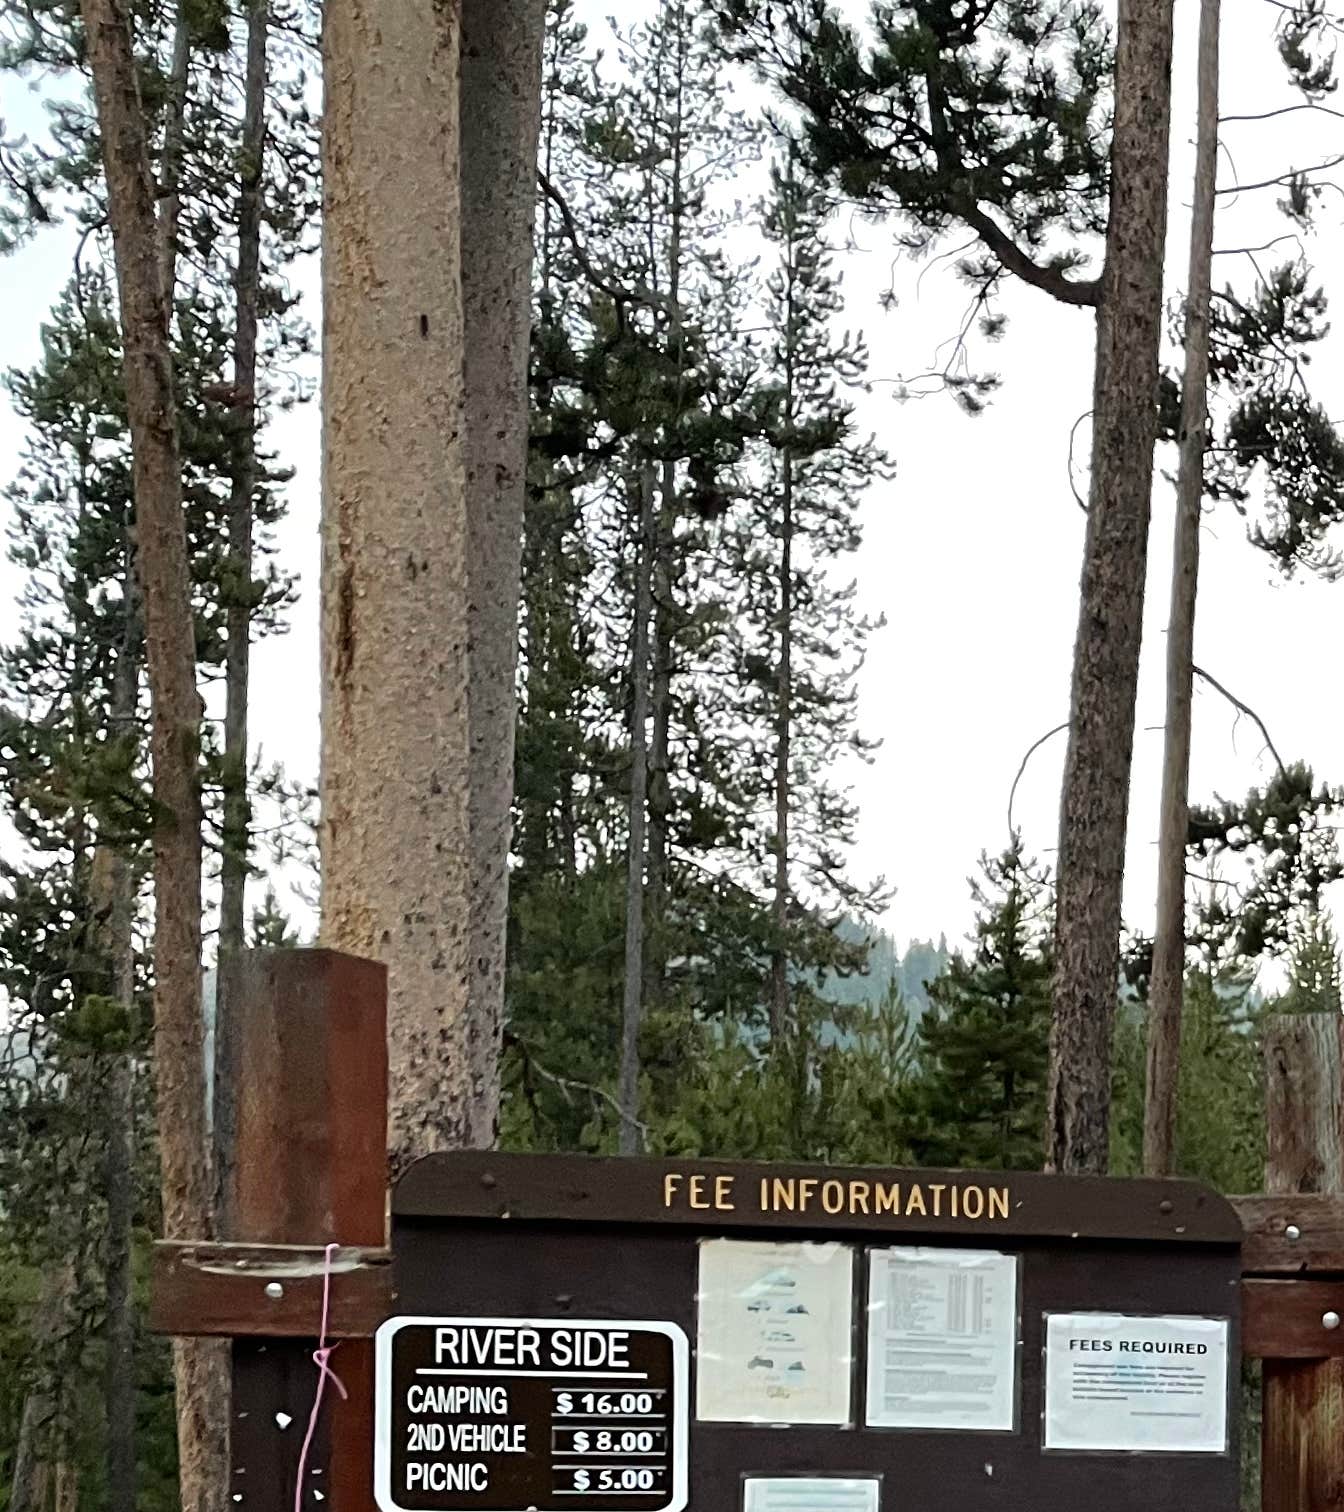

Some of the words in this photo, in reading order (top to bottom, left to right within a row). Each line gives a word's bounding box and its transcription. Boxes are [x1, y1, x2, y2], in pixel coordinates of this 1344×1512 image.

[664, 1174, 735, 1210] FEE
[760, 1178, 1010, 1219] INFORMATION
[435, 1328, 540, 1365] RIVER
[550, 1331, 629, 1367] SIDE
[1069, 1340, 1113, 1352] FEES
[1120, 1341, 1208, 1355] REQUIRED
[407, 1385, 507, 1414] CAMPING
[556, 1393, 573, 1414] $
[581, 1394, 652, 1414] 16.00
[407, 1424, 445, 1451] 2ND
[448, 1424, 526, 1452] VEHICLE
[573, 1432, 589, 1452] $
[596, 1431, 653, 1452] 8.00
[406, 1463, 488, 1491] PICNIC
[573, 1469, 590, 1491] $
[598, 1469, 653, 1490] 5.00
